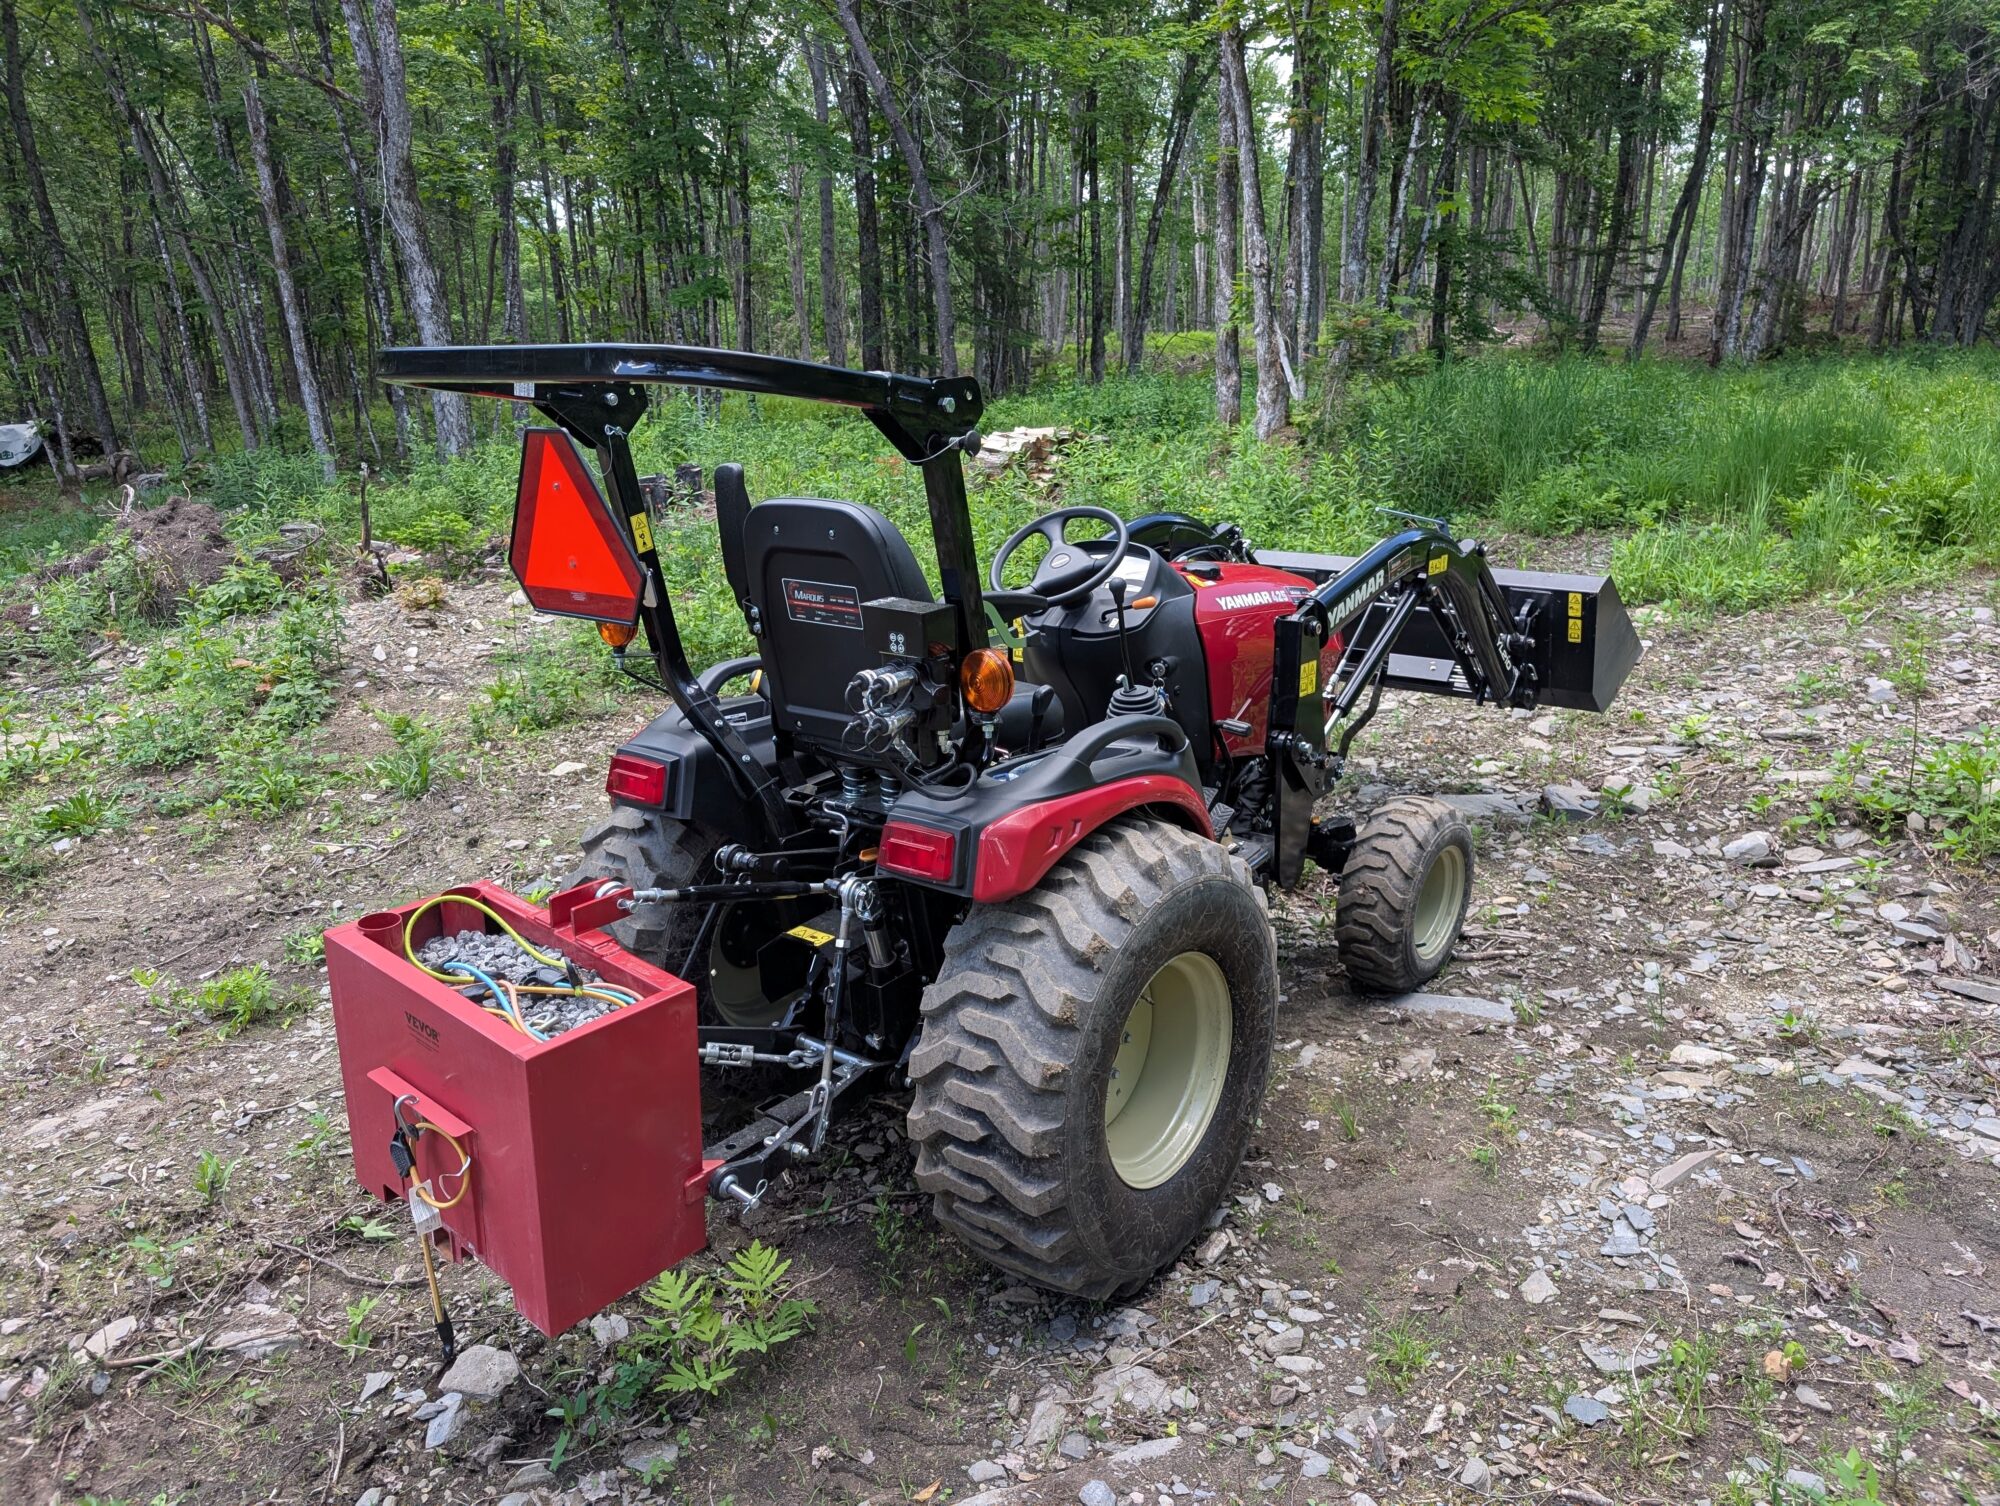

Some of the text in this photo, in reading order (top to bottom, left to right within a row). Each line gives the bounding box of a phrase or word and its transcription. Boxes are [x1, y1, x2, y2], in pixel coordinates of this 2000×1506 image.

[1215, 591, 1272, 610] YANMAR
[1271, 590, 1289, 602] 425
[1328, 569, 1385, 628] YANMAR
[404, 1010, 439, 1043] VEVOR
